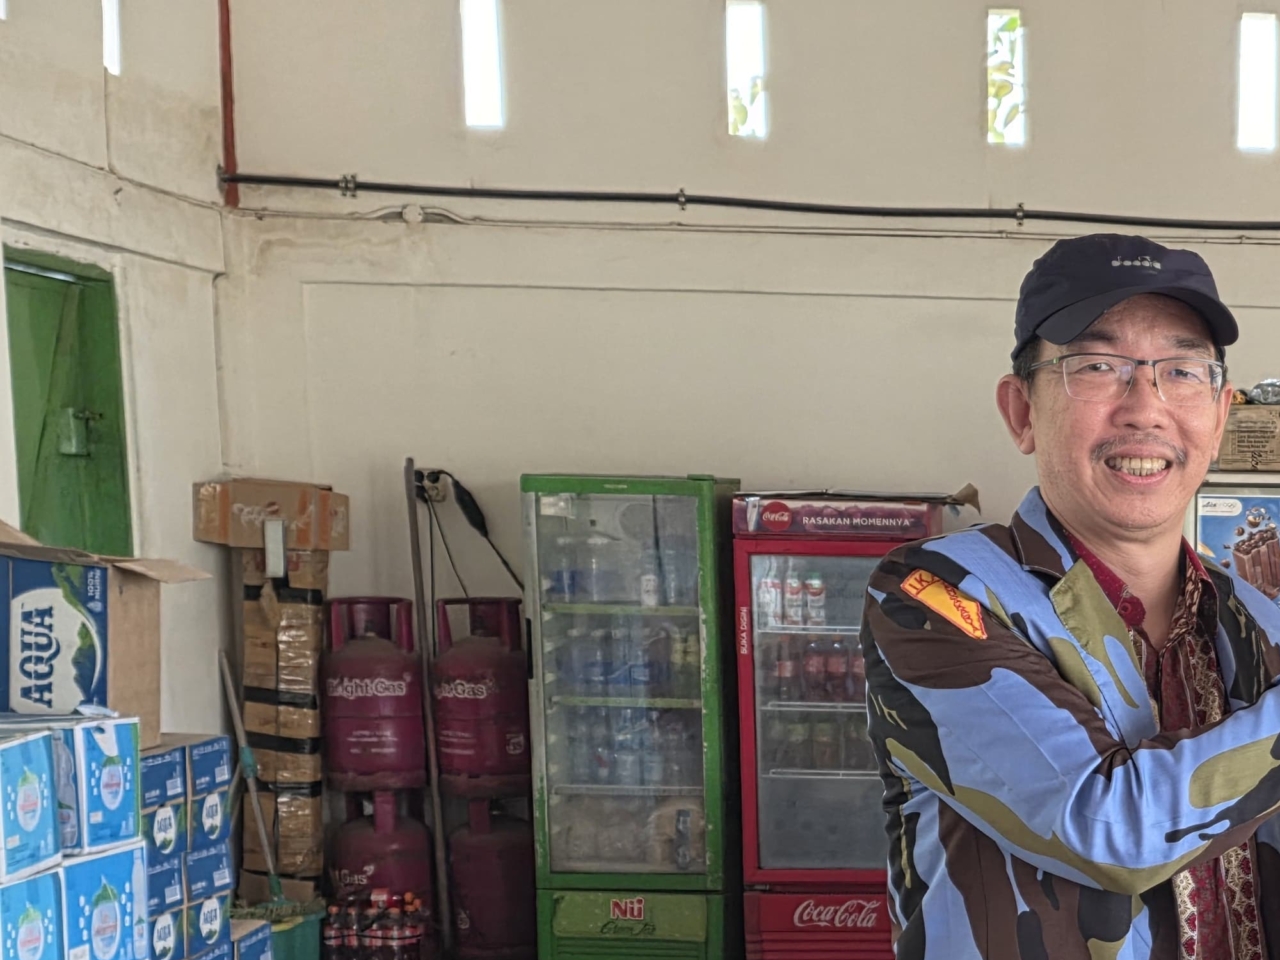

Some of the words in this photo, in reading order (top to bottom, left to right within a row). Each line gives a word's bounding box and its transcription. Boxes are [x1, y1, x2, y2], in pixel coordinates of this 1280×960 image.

[803, 516, 849, 525] RASAKAN
[852, 517, 910, 526] MOMENNYA
[741, 606, 749, 630] DISINI
[740, 632, 748, 654] BUKA
[19, 604, 60, 708] AQUA
[374, 678, 406, 697] Gas
[454, 680, 487, 698] Gas
[205, 805, 218, 819] AQUA
[156, 816, 172, 835] AQUA
[202, 906, 218, 925] AQUA
[793, 899, 881, 928] Coca-Cola
[156, 924, 172, 943] AQUA
